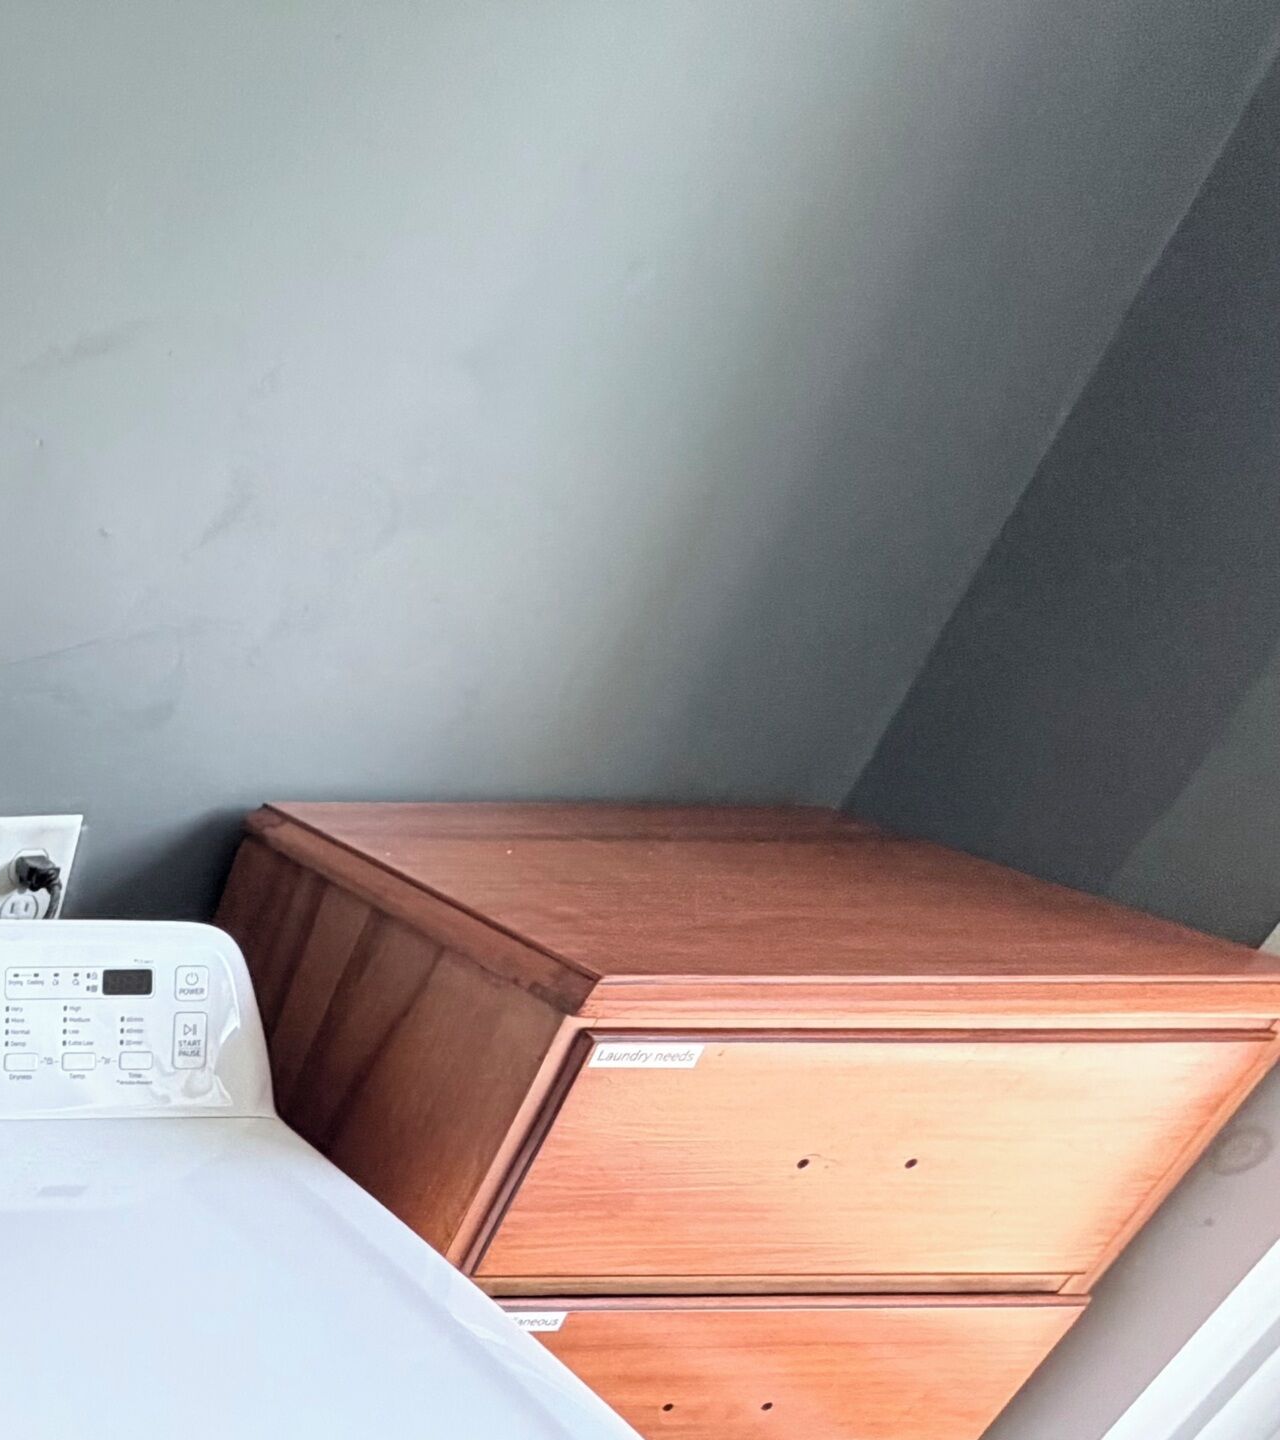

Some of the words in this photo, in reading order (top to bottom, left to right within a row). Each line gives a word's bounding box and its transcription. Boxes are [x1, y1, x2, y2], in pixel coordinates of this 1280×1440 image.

[178, 987, 206, 995] POWER
[178, 1039, 201, 1047] START
[177, 1048, 201, 1057] PAUSE
[596, 1049, 654, 1063] Laundry
[653, 1050, 696, 1063] needs
